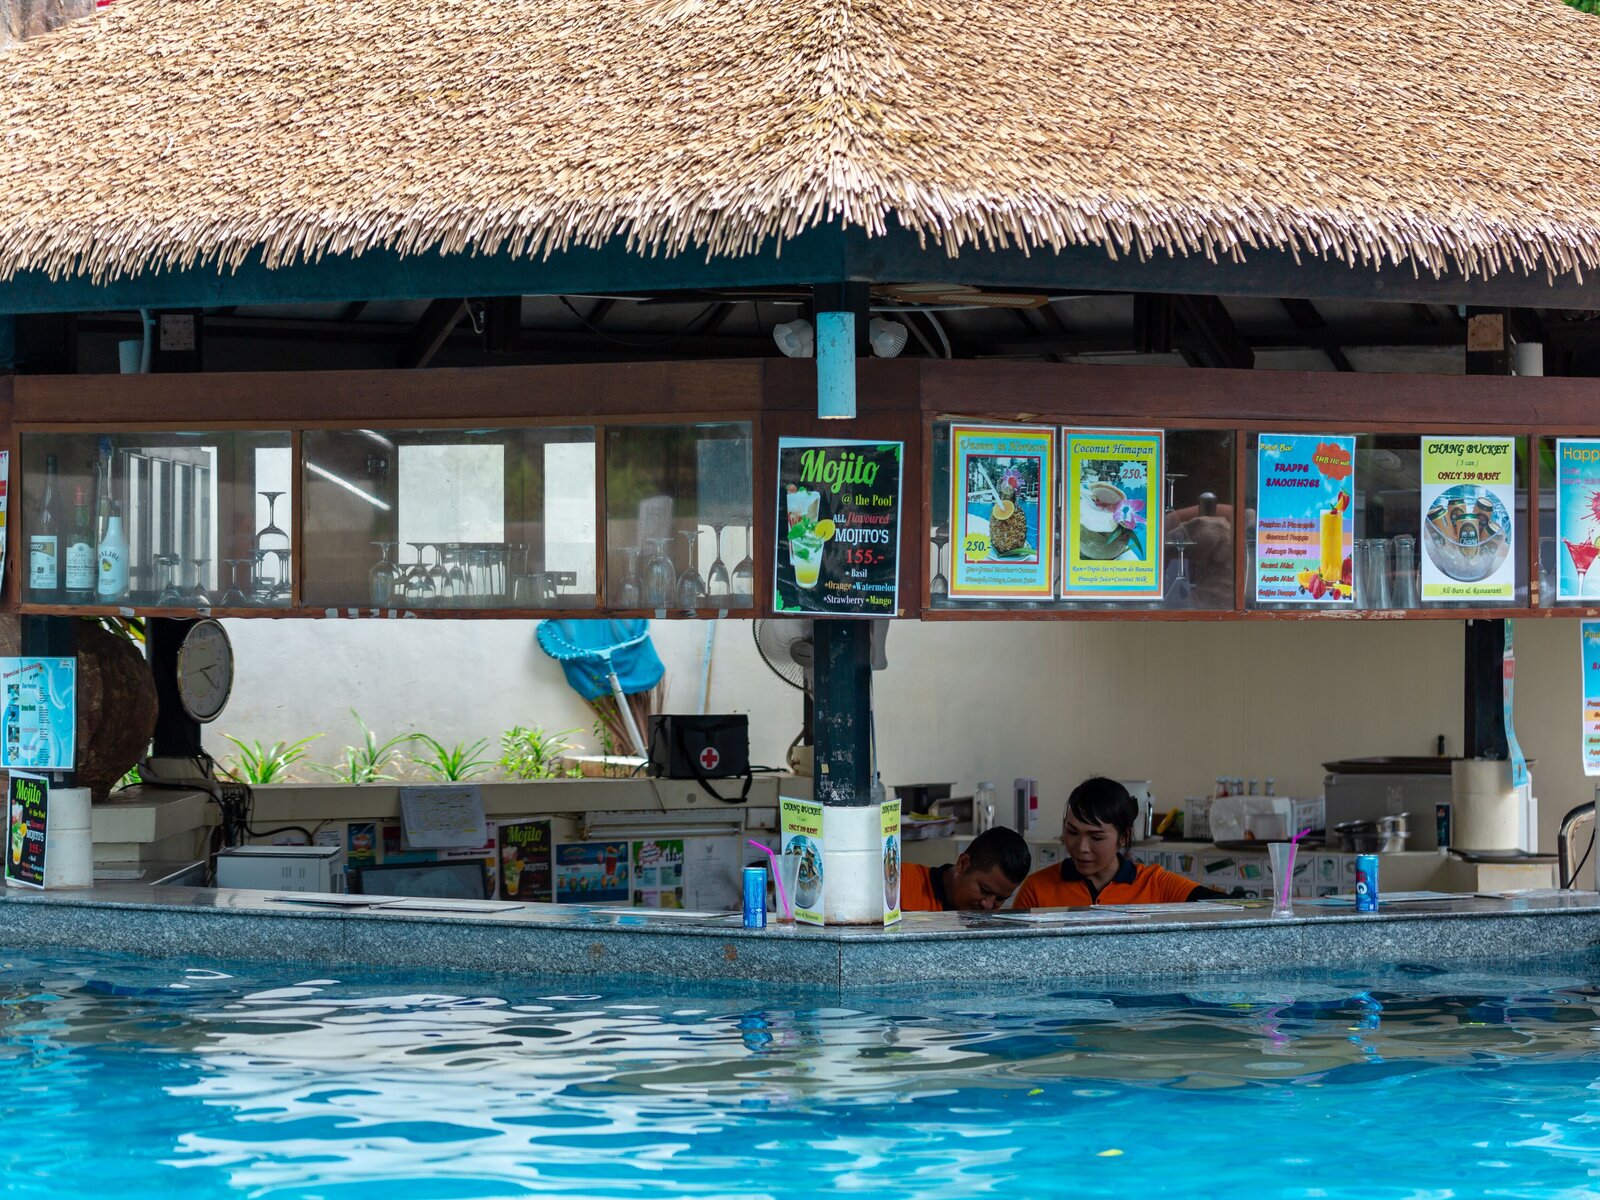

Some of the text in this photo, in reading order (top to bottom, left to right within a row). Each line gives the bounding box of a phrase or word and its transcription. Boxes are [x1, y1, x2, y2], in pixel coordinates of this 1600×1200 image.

[1073, 443, 1153, 457] Coconut Himapan
[1428, 444, 1510, 456] CHANG BUCKET
[1563, 447, 1600, 463] Happ
[800, 449, 880, 494] Mojito
[1274, 463, 1309, 473] FRAPPE
[1438, 472, 1501, 480] ONLY 399 BAHT
[1266, 478, 1320, 488] SMOOTHIES
[842, 495, 892, 507] @ the Pool
[833, 512, 890, 526] ALL flavoured
[835, 529, 889, 545] MOJITO'S
[965, 541, 991, 552] 250.-
[846, 550, 884, 564] 155.-
[851, 569, 867, 578] Basil
[827, 581, 896, 592] Orange Watermelon
[827, 595, 892, 607] Strawberry Mango
[16, 779, 41, 808] Mojito
[507, 825, 542, 847] Mojito
